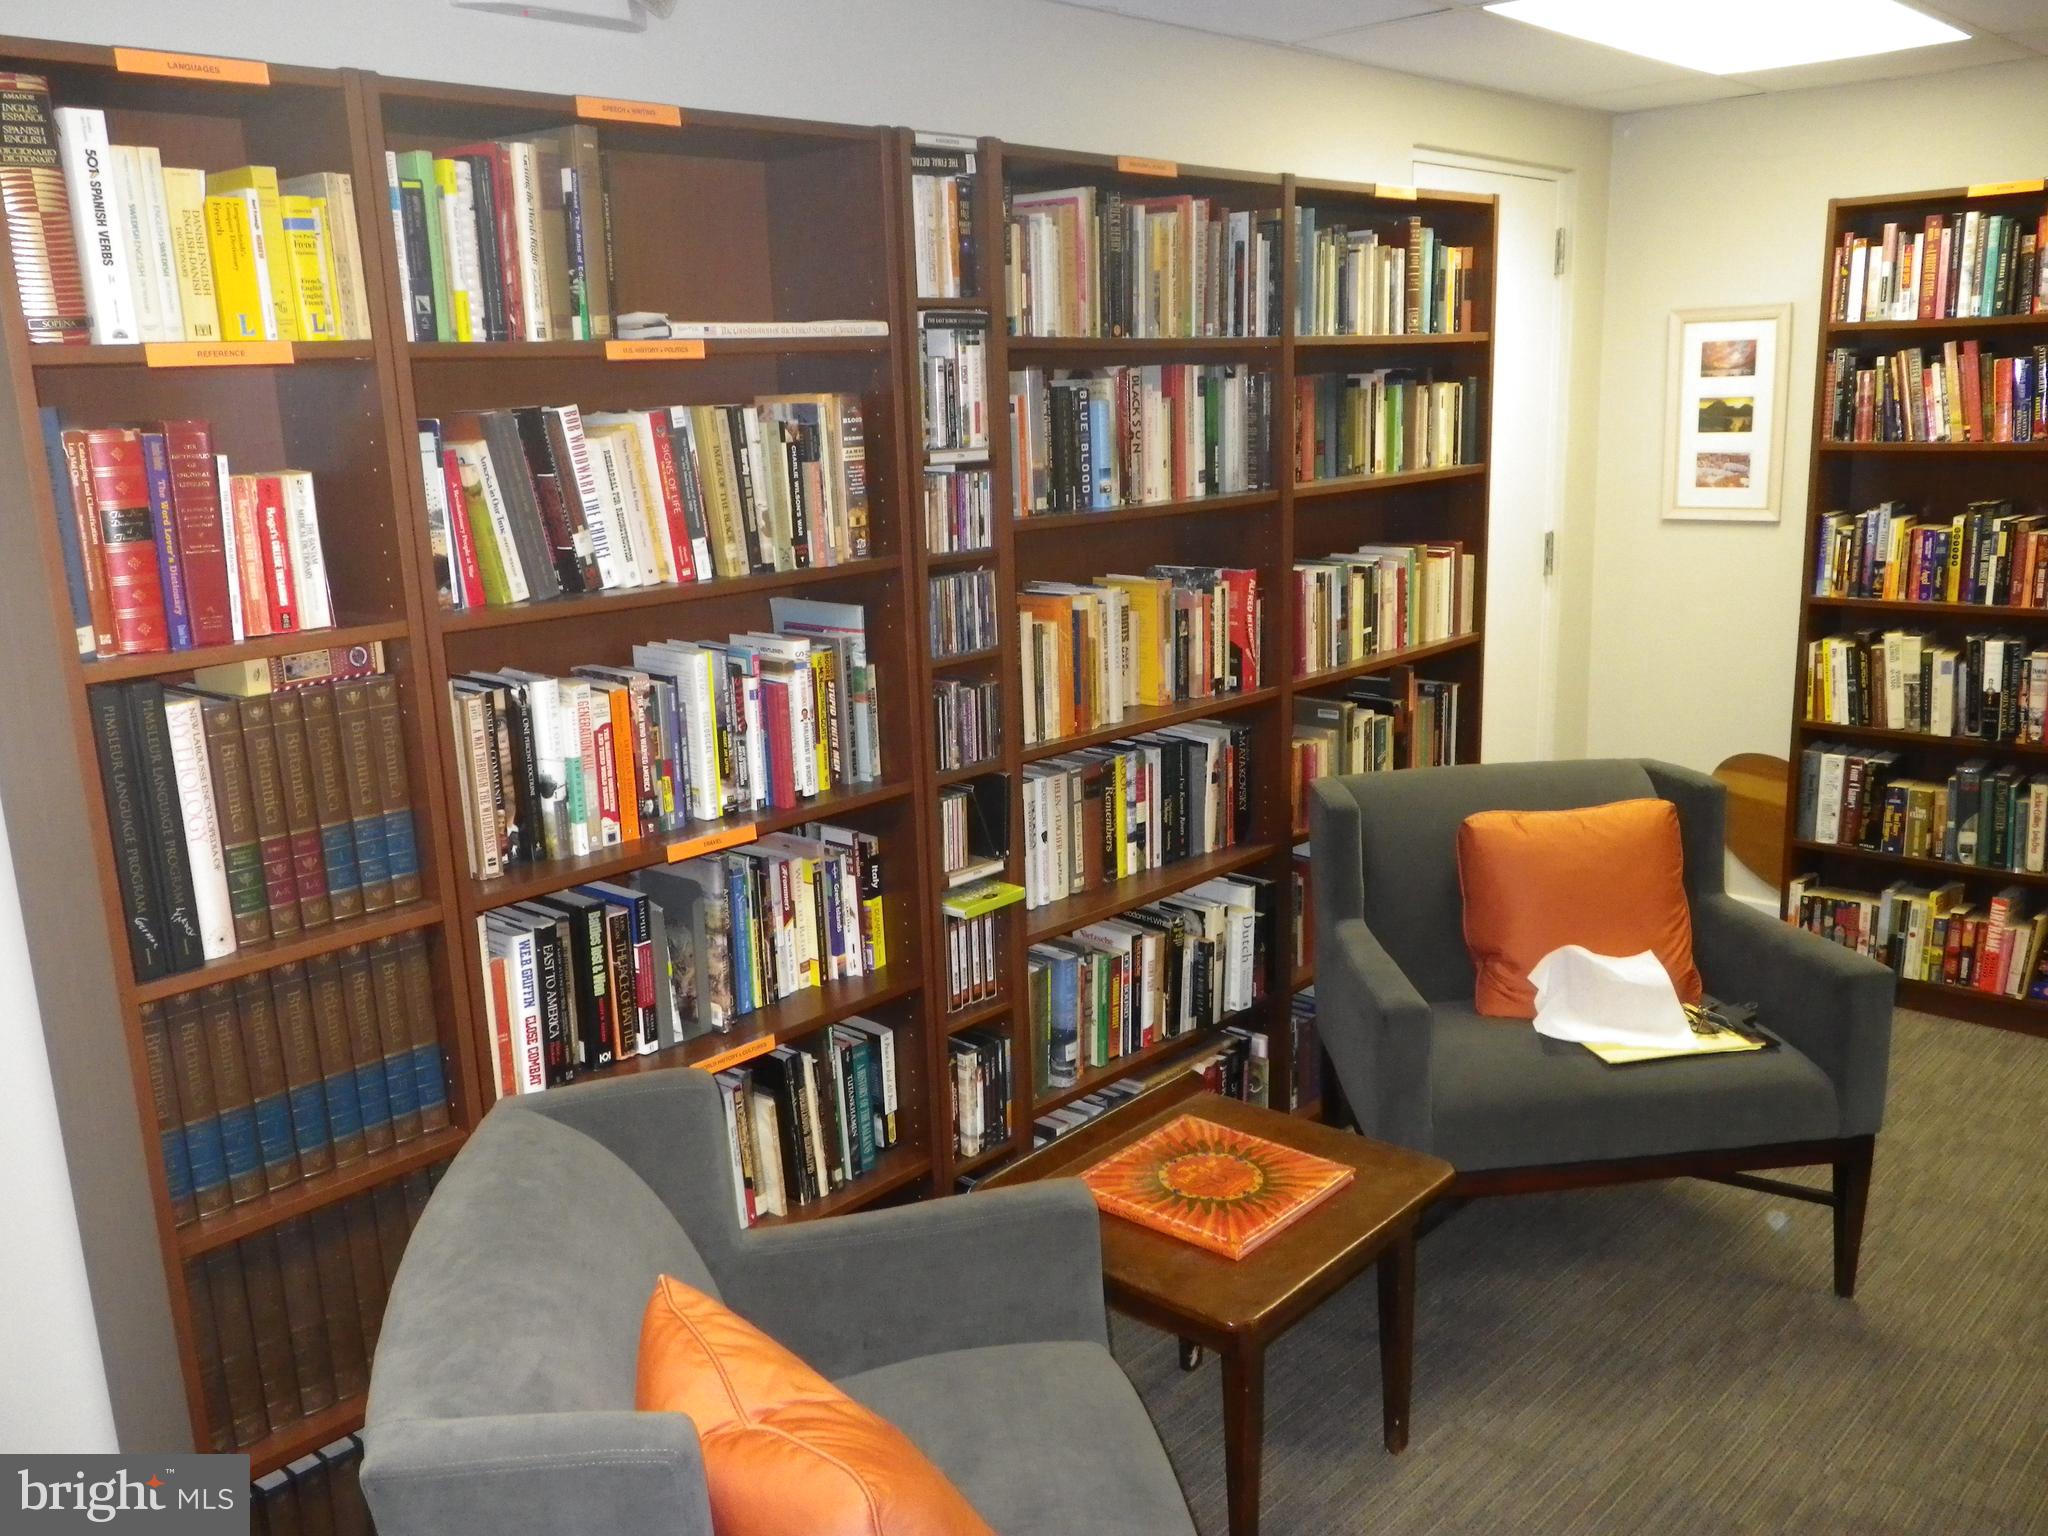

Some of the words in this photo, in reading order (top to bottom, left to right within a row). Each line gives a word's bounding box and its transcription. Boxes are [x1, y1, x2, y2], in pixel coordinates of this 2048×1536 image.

[167, 62, 220, 75] LANGUAGES
[2, 125, 44, 136] SPANISH
[4, 135, 46, 145] ENGLISH
[84, 146, 100, 174] 501
[931, 157, 946, 166] FINAL
[947, 157, 958, 167] THE
[88, 179, 109, 227] SPANISH
[211, 201, 224, 236] French
[96, 229, 114, 267] VERBS
[197, 349, 246, 358] REFERENCE
[2036, 346, 2048, 368] STEVE
[1130, 374, 1140, 416] BLACK
[2035, 369, 2047, 394] BERRY
[561, 408, 581, 432] BOB
[1078, 389, 1088, 431] BLUE
[1132, 420, 1142, 453] SUN
[75, 441, 90, 481] Cataloging
[567, 433, 597, 496] WOODWARD
[660, 442, 674, 475] SIGNS
[790, 444, 799, 478] CHARLIE
[1079, 443, 1090, 493] BLOOD
[83, 481, 92, 496] and
[157, 478, 167, 498] The
[667, 477, 677, 492] OF
[793, 480, 802, 517] WILSON'S
[159, 500, 171, 526] Word
[582, 497, 601, 517] THE
[669, 493, 682, 514] LIFE
[85, 496, 100, 545] Classification
[1865, 527, 1874, 544] BOX
[163, 527, 176, 564] Lover's
[587, 519, 612, 560] CHOICE
[166, 564, 183, 616] Dictionary
[1245, 578, 1257, 612] ALFRED
[1119, 605, 1129, 642] ROOTS
[823, 652, 831, 679] MOORE
[826, 680, 836, 715] STUPID
[139, 698, 162, 759] PIMSLEUR
[187, 706, 199, 730] NEW
[520, 717, 530, 734] ONE
[576, 699, 595, 751] GENERATION
[829, 717, 839, 748] WHITE
[191, 731, 208, 783] LAROUSSE
[347, 720, 376, 805] Britannica
[522, 735, 534, 763] PERCENT
[584, 753, 597, 770] KILL
[831, 749, 841, 771] MEN
[170, 706, 208, 845] MYTHOLOGY
[217, 743, 246, 833] Britannica
[252, 736, 282, 824] Britannica
[282, 730, 311, 818] Britannica
[526, 763, 538, 796] DOCTRINE
[641, 765, 649, 791] AMERICA
[1118, 756, 1128, 795] KOOP
[1848, 763, 1861, 781] Tom
[98, 704, 124, 769] PIMSLEUR
[111, 773, 137, 843] LANGUAGE
[124, 847, 149, 913] PROGRAM
[149, 766, 175, 835] LANGUAGE
[1846, 782, 1860, 808] Clancy
[199, 784, 220, 857] ENCYCLOPEDIA
[1100, 785, 1117, 852] Remembers
[162, 839, 186, 904] PROGRAM
[779, 864, 792, 911] Frommer's
[869, 864, 879, 888] Italy
[831, 882, 842, 905] Greek
[587, 910, 603, 945] Battles
[637, 899, 647, 940] EMPIRE
[833, 906, 844, 932] Islands
[1984, 902, 2006, 954] AIRFRAME
[517, 938, 532, 968] W.E.B.
[615, 940, 628, 962] THE
[1239, 914, 1253, 964] Dutch
[541, 943, 554, 970] EAST
[591, 964, 604, 973] &
[520, 968, 536, 1008] GRIFFIN
[543, 972, 556, 988] TO
[591, 971, 606, 996] Won
[617, 965, 630, 990] FACE
[545, 990, 560, 1039] AMERICA
[619, 990, 631, 1006] OF
[524, 1014, 539, 1045] CLOSE
[620, 1007, 635, 1047] BATTLE
[526, 1046, 542, 1086] COMBAT
[855, 1069, 868, 1097] HISTORY
[846, 1074, 857, 1137] TUTANKHAMEN
[858, 1098, 869, 1108] OF
[859, 1109, 870, 1123] THE
